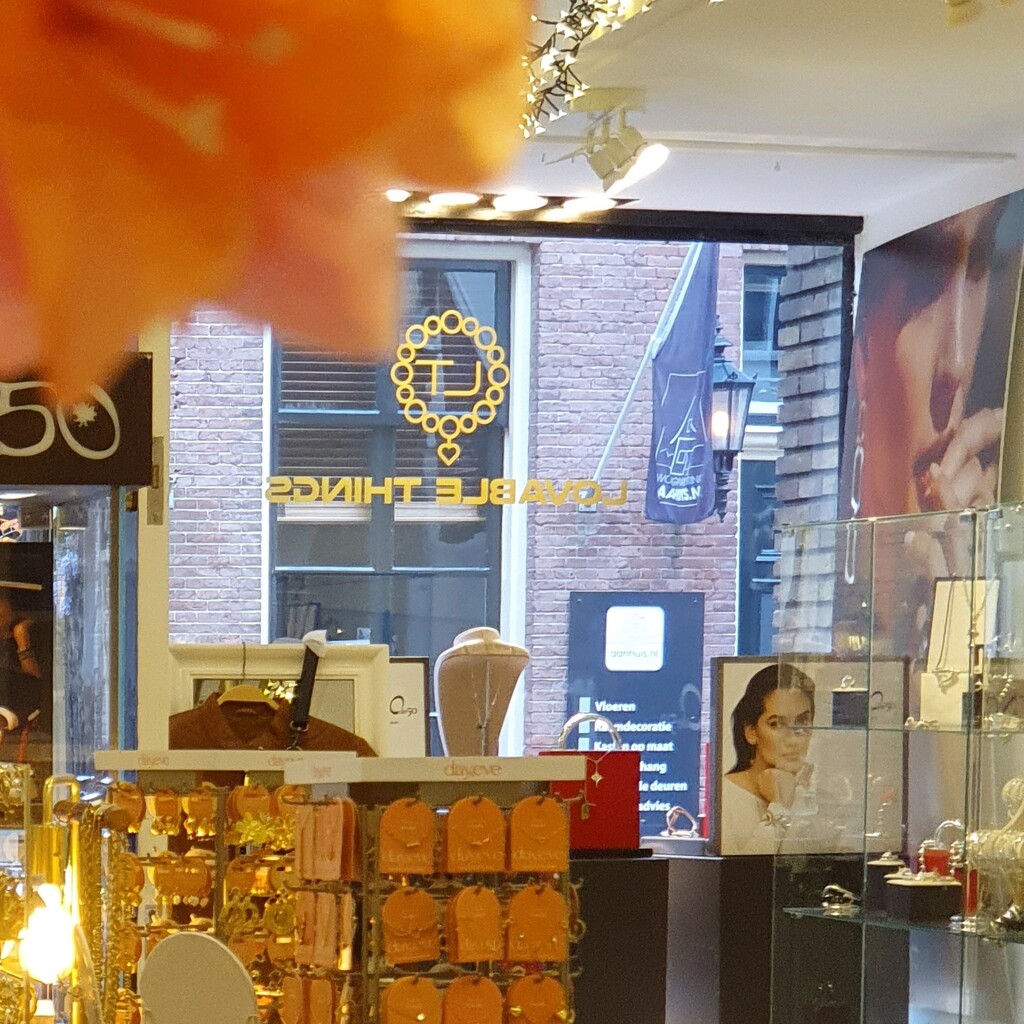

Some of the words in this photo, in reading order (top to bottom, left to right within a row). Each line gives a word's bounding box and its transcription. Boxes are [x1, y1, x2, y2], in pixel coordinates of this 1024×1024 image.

[595, 701, 636, 712] Vloeren
[647, 741, 674, 751] maat
[650, 780, 688, 791] deuren
